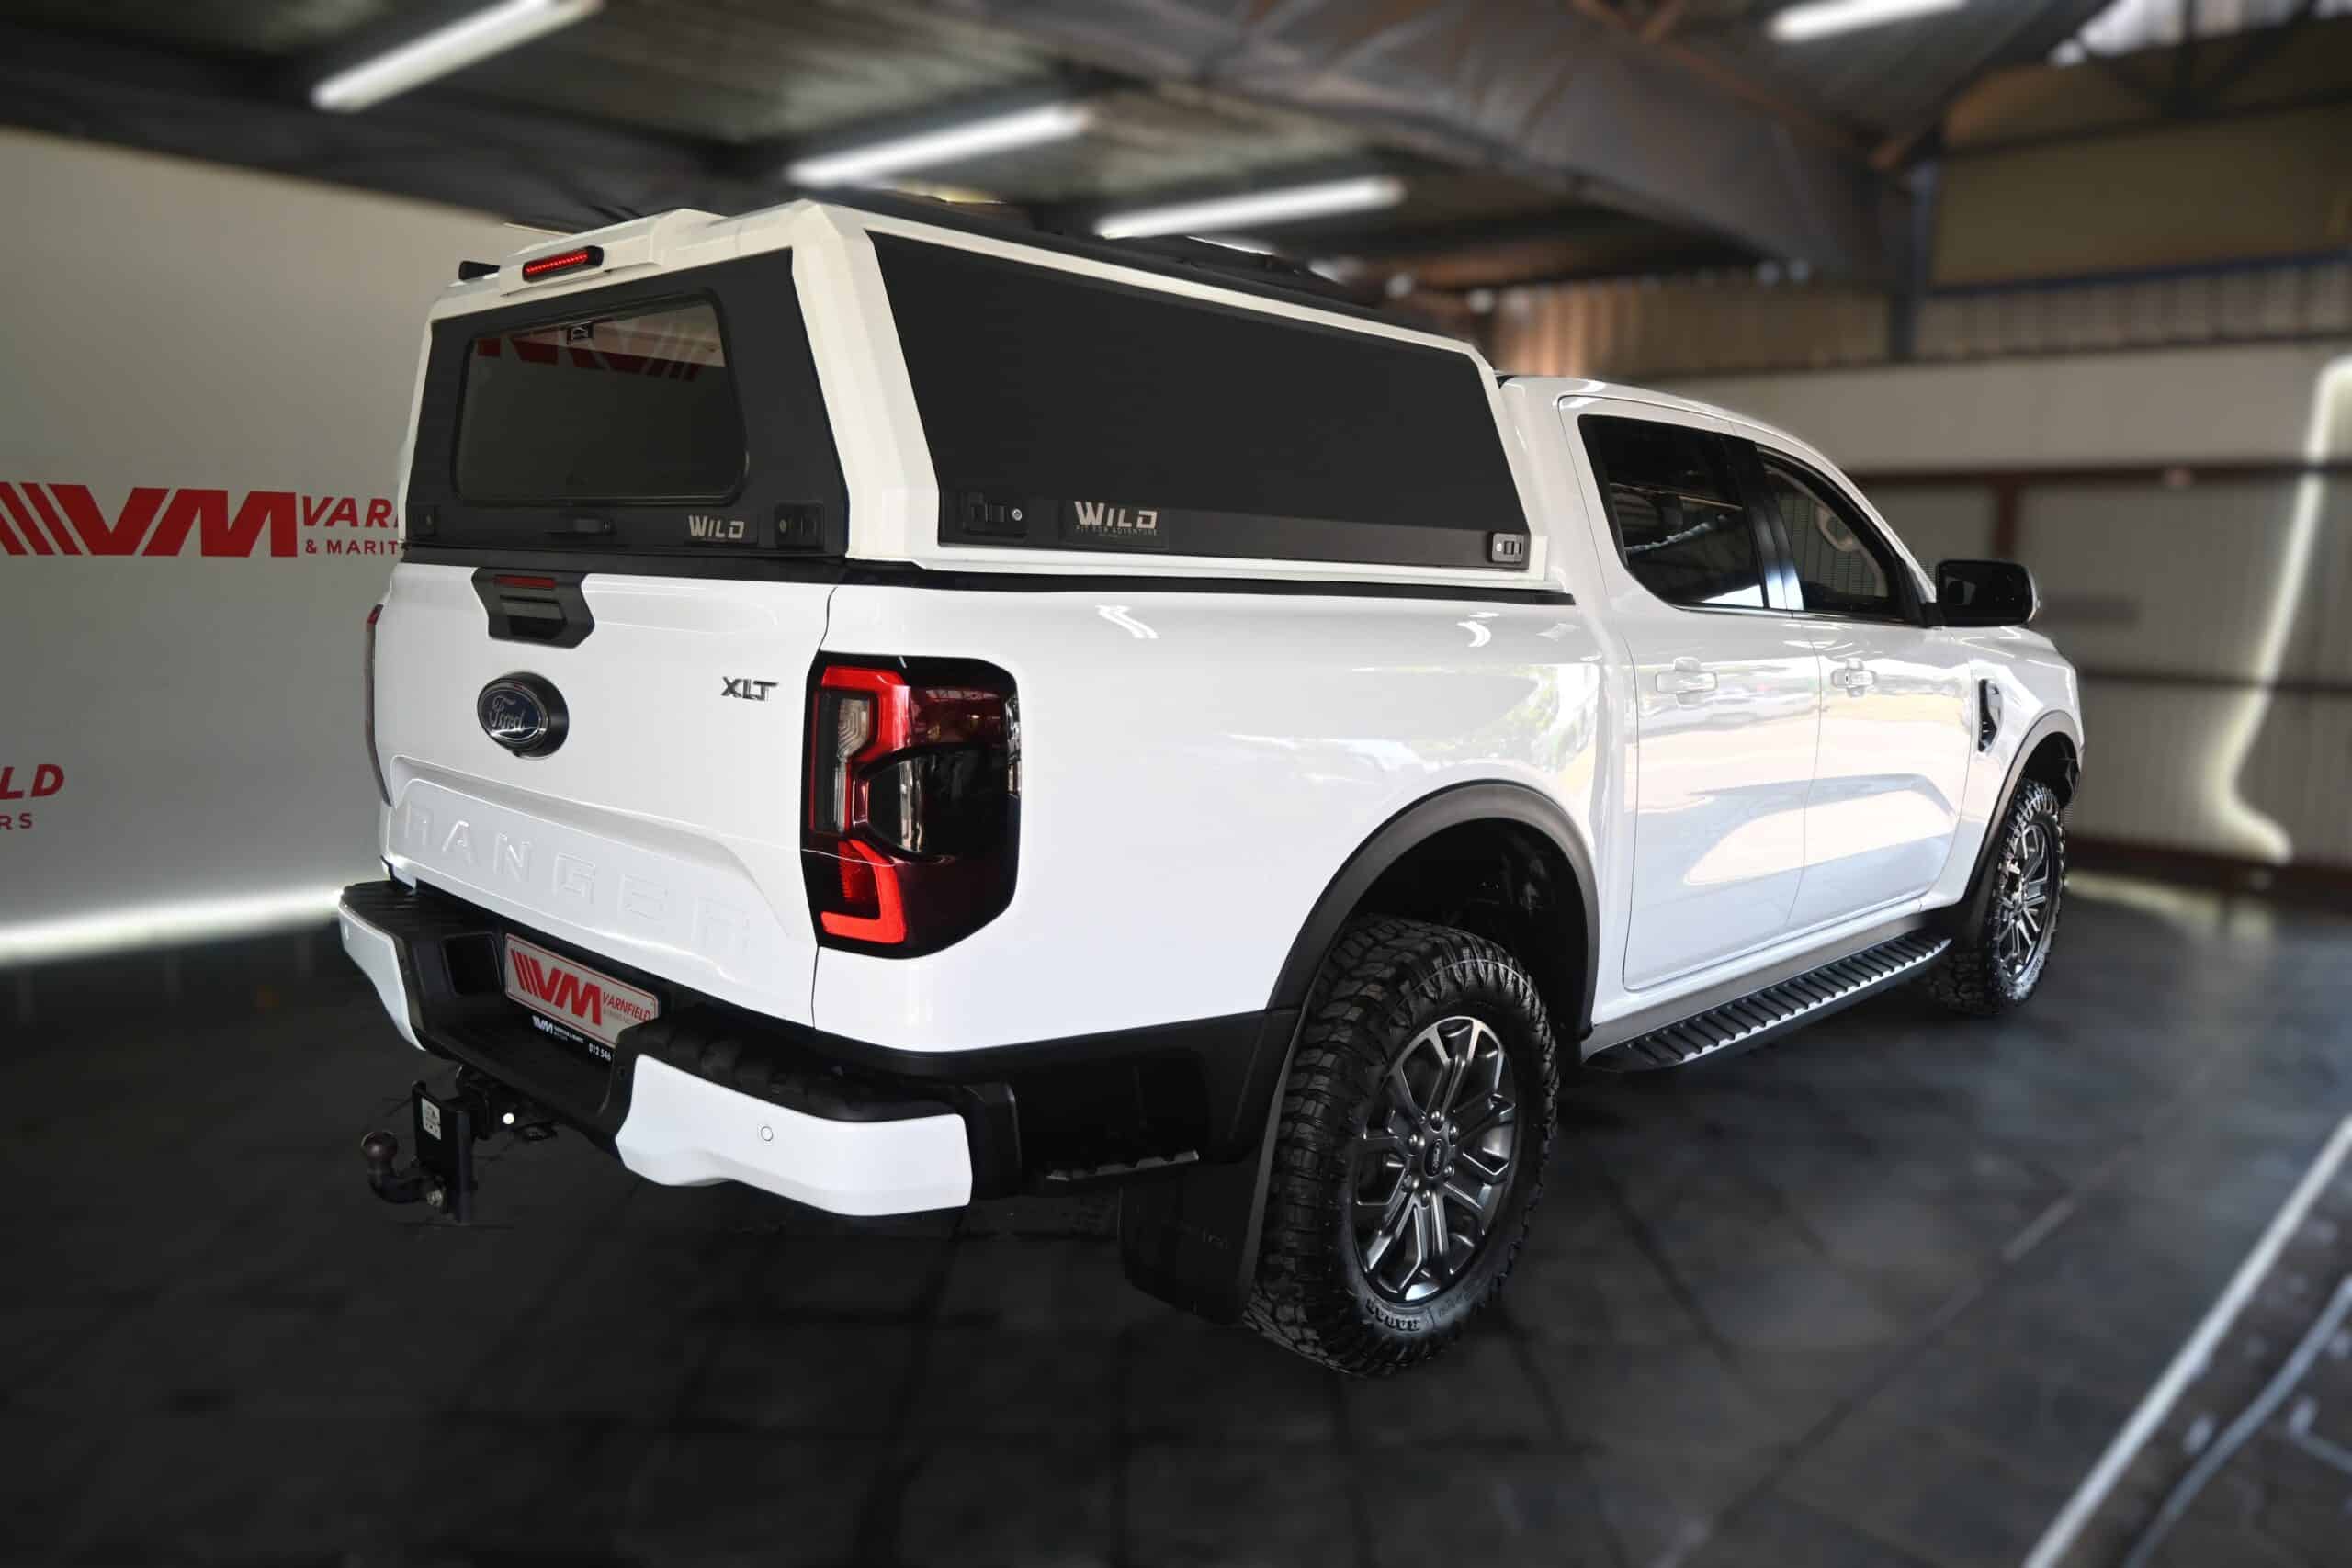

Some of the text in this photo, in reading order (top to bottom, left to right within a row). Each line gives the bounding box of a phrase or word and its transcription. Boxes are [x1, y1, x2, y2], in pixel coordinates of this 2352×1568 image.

[302, 496, 398, 527] VAR
[1073, 501, 1158, 529] WILD
[687, 513, 745, 540] WILD
[305, 538, 317, 554] &
[720, 676, 779, 702] XLT
[489, 694, 527, 732] Ford
[403, 795, 753, 951] RANGER
[602, 991, 651, 1023] VARNFIELD
